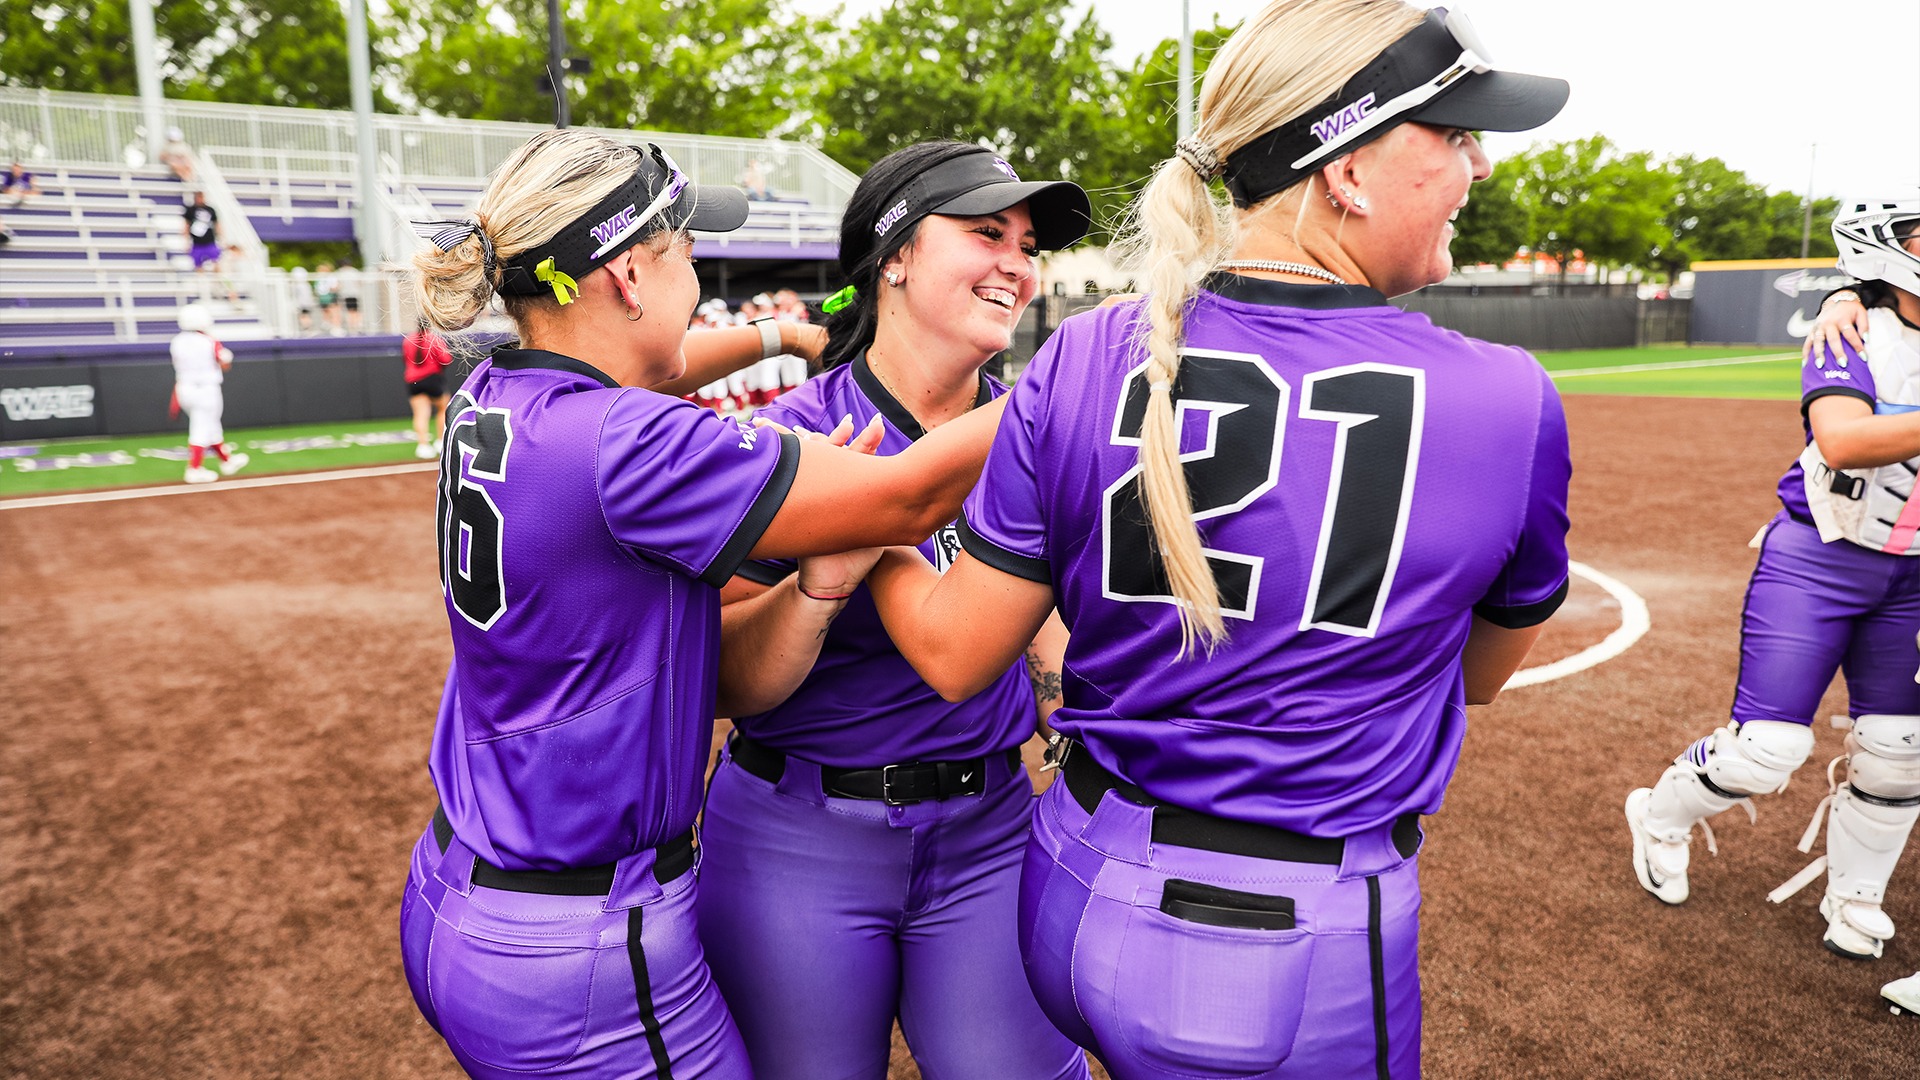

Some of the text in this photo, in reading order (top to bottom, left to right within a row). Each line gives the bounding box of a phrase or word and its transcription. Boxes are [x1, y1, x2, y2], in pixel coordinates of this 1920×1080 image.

[1310, 92, 1379, 145] WAC
[590, 203, 637, 245] WAC
[874, 199, 908, 237] WAC
[1102, 347, 1426, 638] 21
